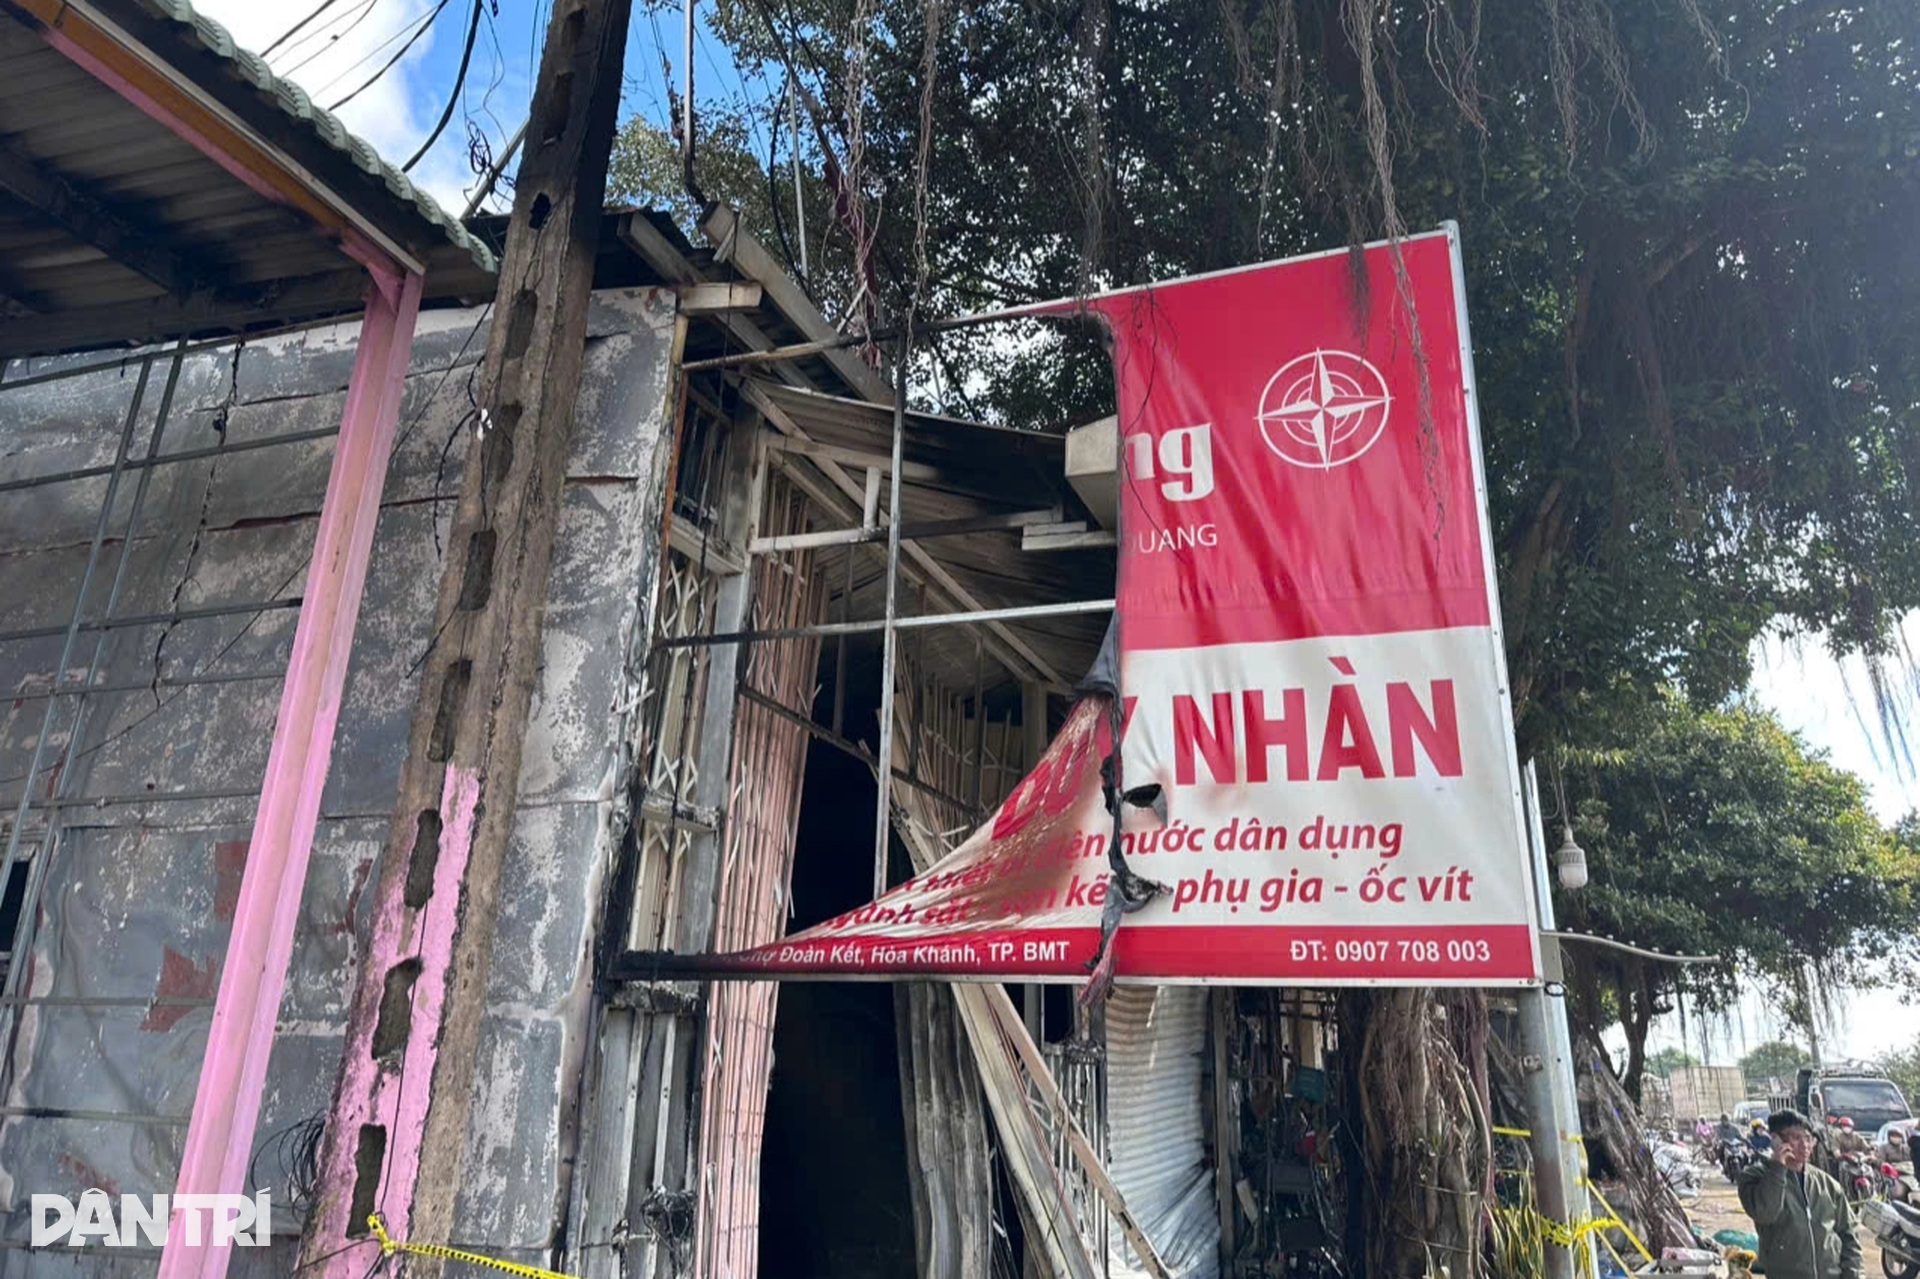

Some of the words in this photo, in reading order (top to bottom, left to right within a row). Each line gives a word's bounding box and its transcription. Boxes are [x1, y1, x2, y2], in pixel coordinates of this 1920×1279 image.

[1172, 656, 1464, 786] NHÀN
[1213, 817, 1288, 852] dân
[1298, 815, 1403, 860] dụng
[1171, 870, 1250, 913] phụ
[1260, 869, 1323, 913] gia
[1359, 863, 1408, 904] ốc
[1417, 865, 1474, 902] vít
[779, 945, 824, 964] Đoàn
[830, 941, 865, 968] Kết,
[871, 944, 907, 964] Hòa
[913, 941, 981, 966] Khánh,
[987, 943, 1017, 962] TP.
[1023, 941, 1070, 962] BMT
[1290, 940, 1328, 962] ĐT:
[1335, 940, 1390, 962] 0907
[1397, 940, 1440, 962] 708
[1447, 940, 1491, 962] 003
